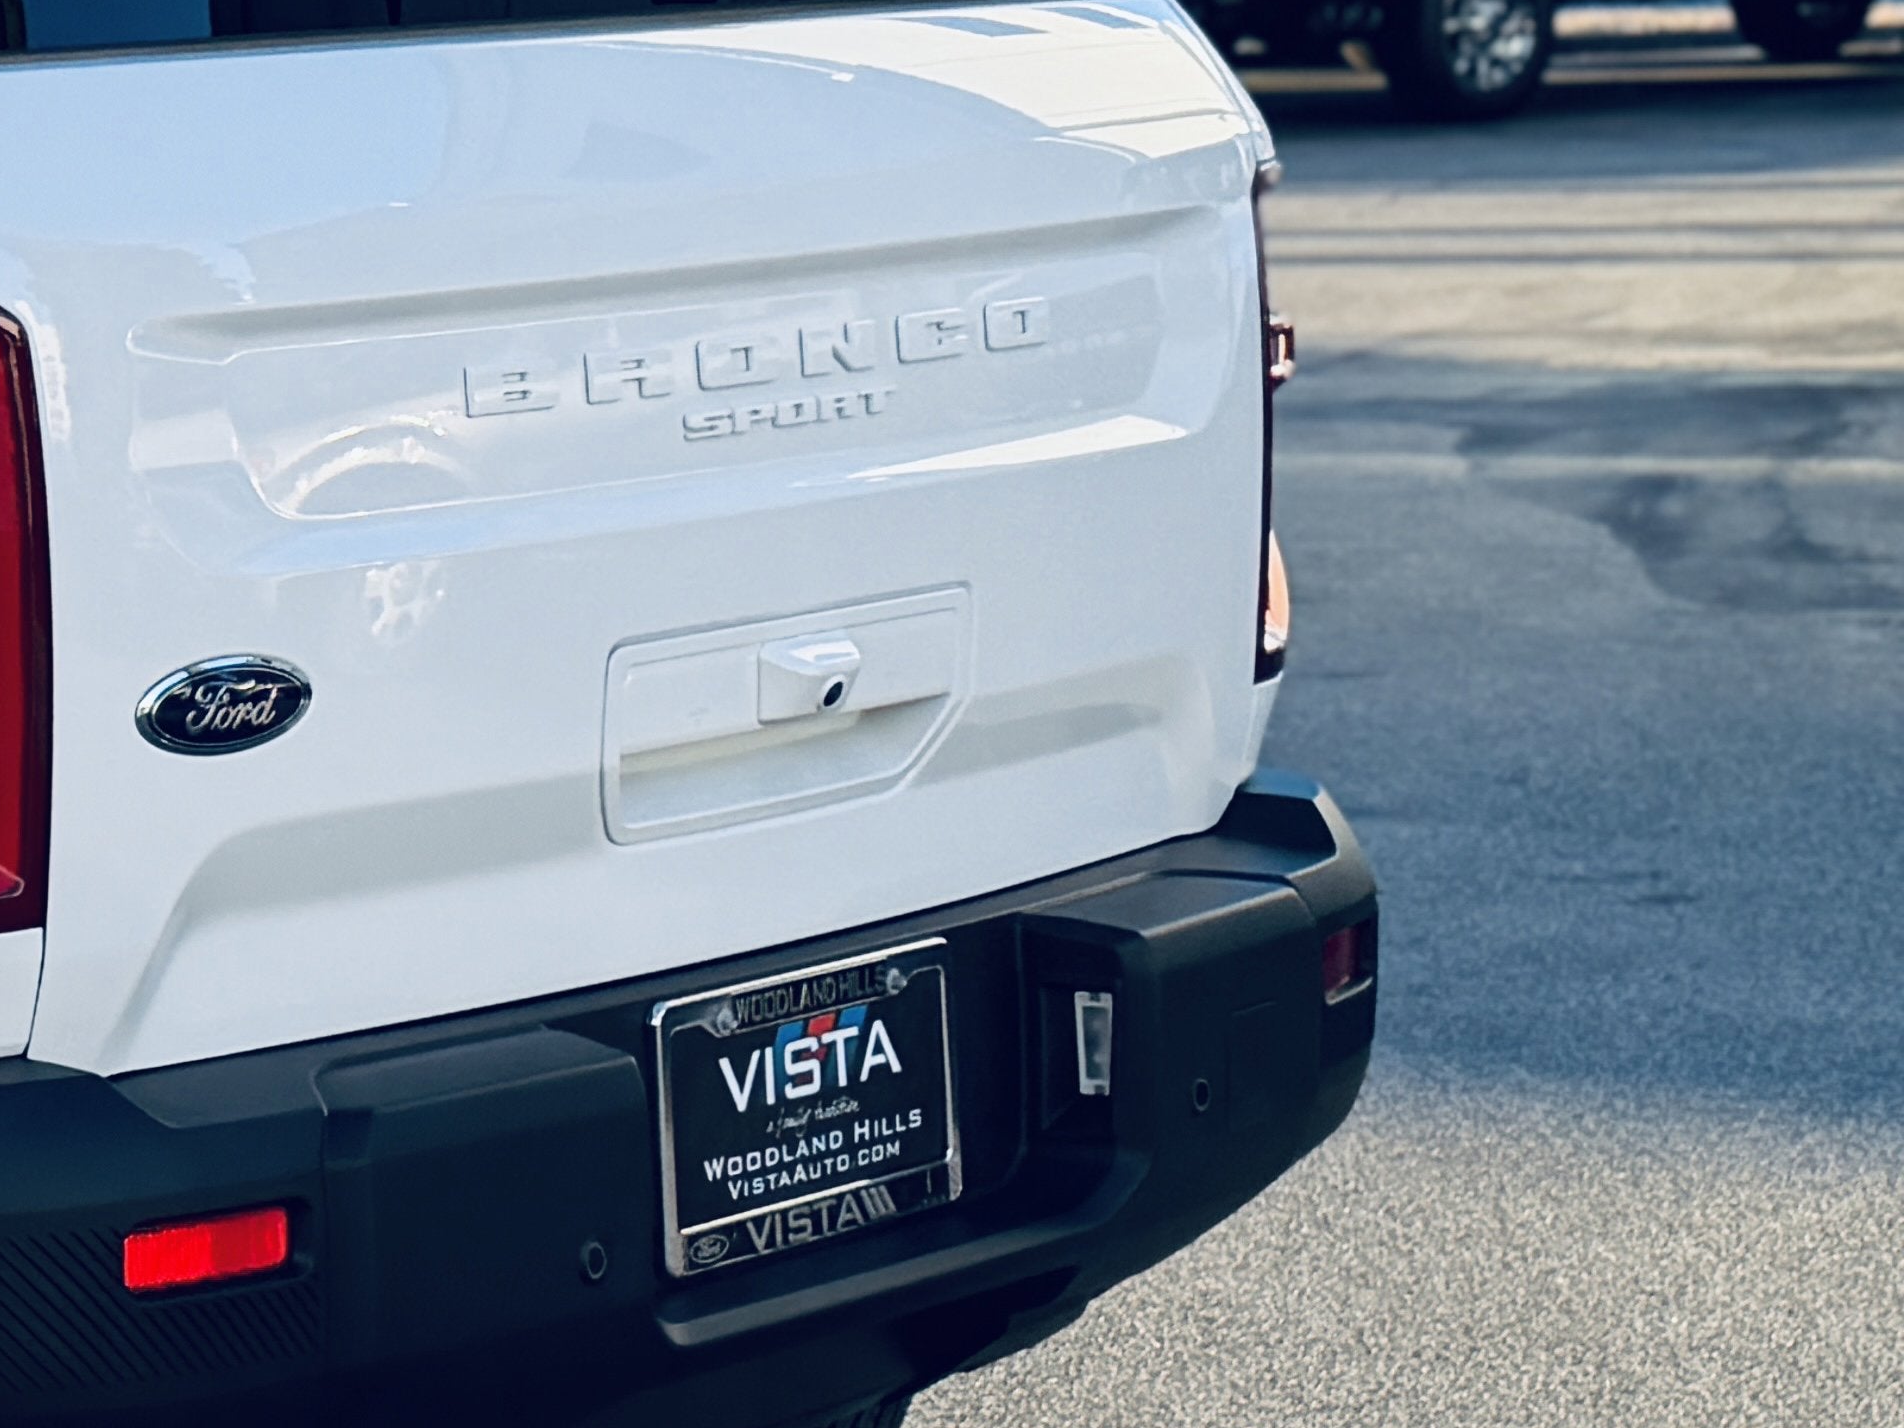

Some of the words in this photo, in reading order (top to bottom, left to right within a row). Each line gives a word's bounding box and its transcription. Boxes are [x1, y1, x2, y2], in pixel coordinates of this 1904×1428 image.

[463, 297, 1049, 419] BRONCO
[682, 385, 898, 442] SPORT
[186, 679, 278, 735] Ford
[735, 977, 837, 1024] WOODLAND
[840, 963, 889, 1000] HILLS
[718, 1019, 903, 1113] VISTA
[703, 1129, 844, 1182] WOODLAND
[853, 1108, 923, 1145] HILLS
[746, 1187, 865, 1254] VISTA
